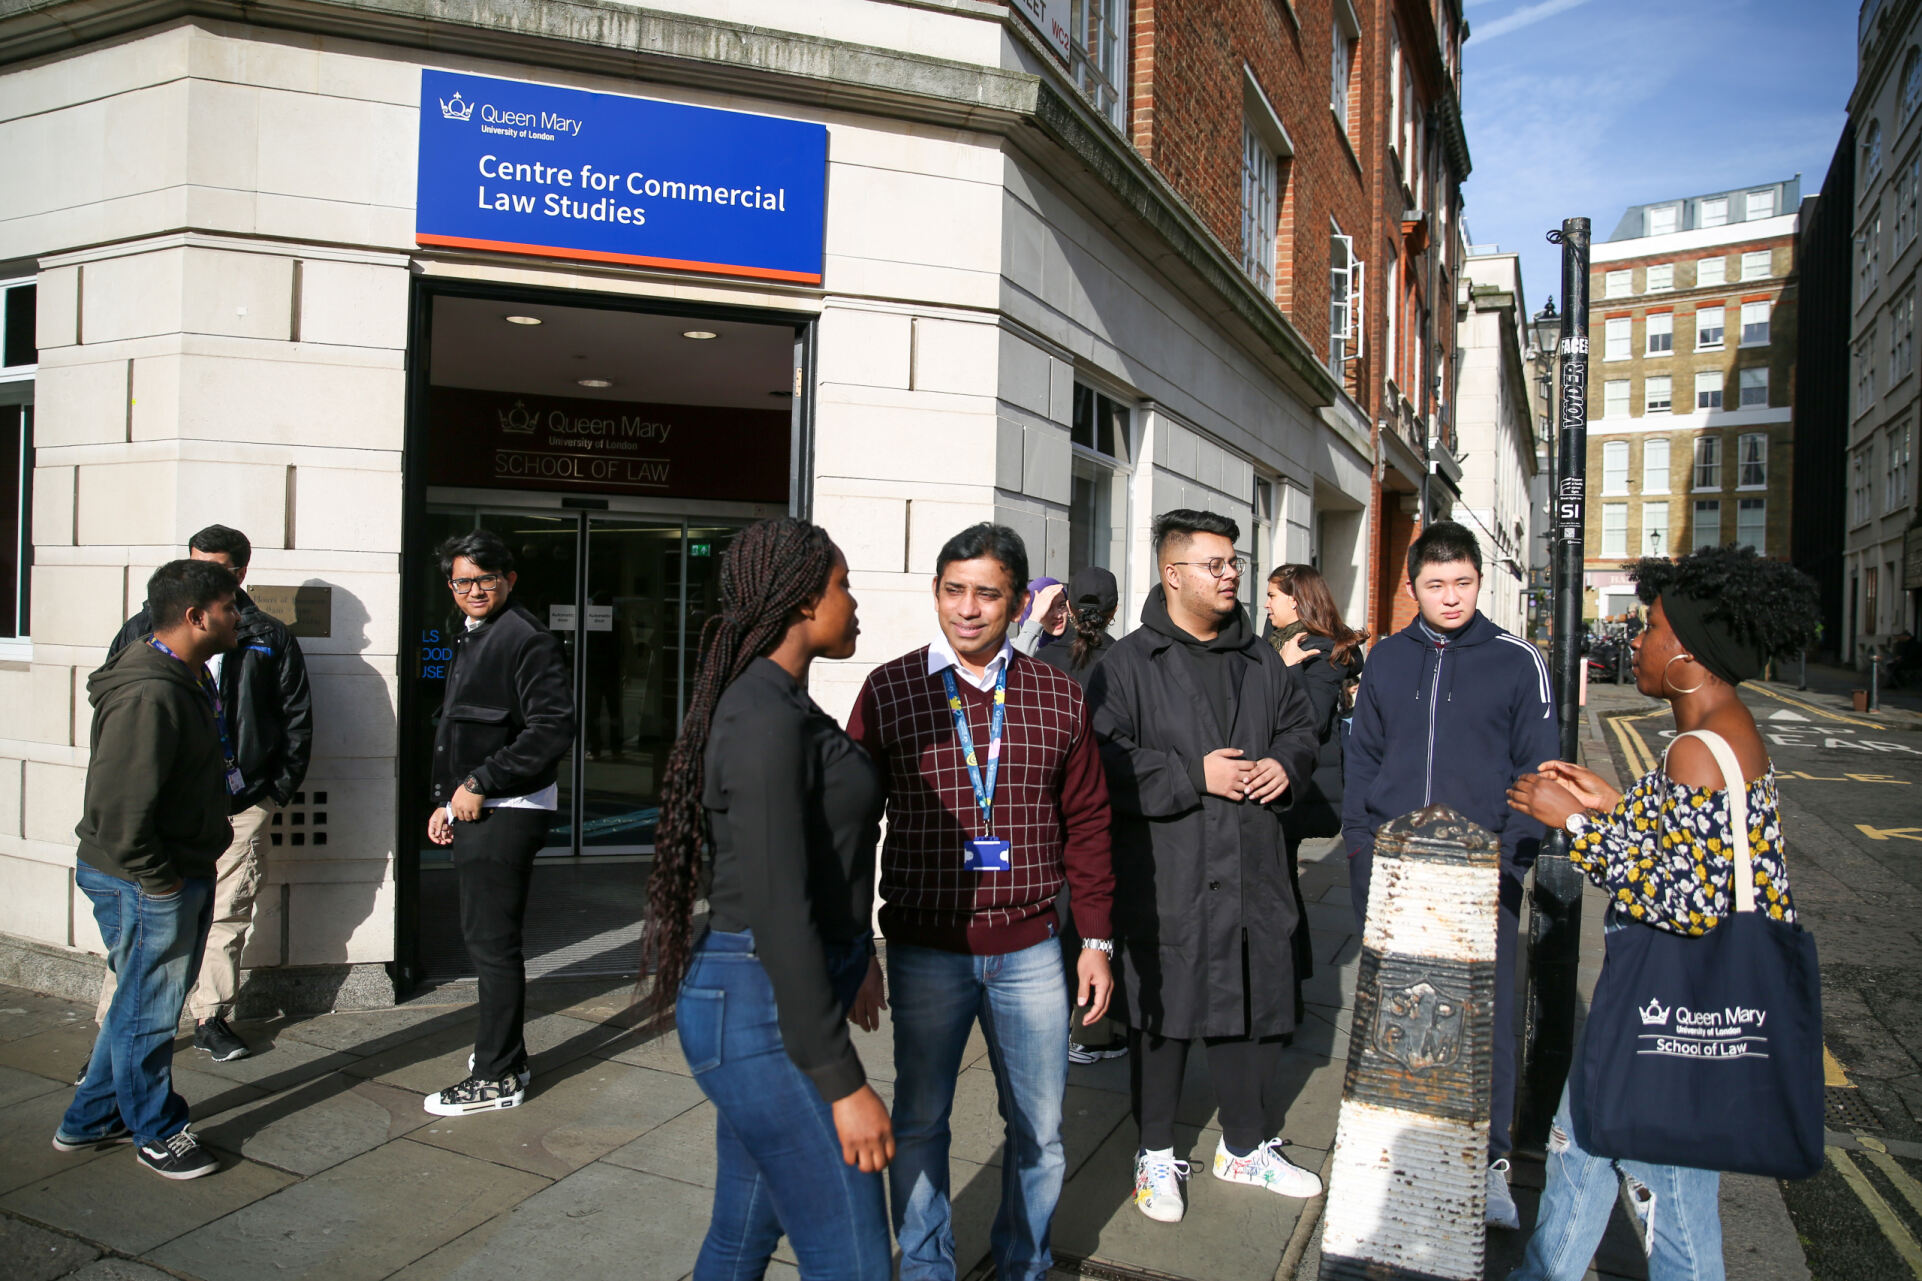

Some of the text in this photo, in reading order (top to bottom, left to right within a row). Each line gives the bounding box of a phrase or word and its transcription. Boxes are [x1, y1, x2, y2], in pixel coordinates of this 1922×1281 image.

[481, 104, 583, 136] Queen Mary
[481, 125, 554, 141] University of London
[479, 155, 786, 212] Centre for Commercial
[478, 186, 646, 226] Law Studies
[548, 410, 671, 444] Queen Mary
[548, 435, 638, 450] University of London
[495, 453, 670, 482] SCHOOL OF LAW
[1676, 1006, 1767, 1027] Queen Mary
[1676, 1025, 1742, 1037] University of London
[1656, 1039, 1748, 1056] School of Law
